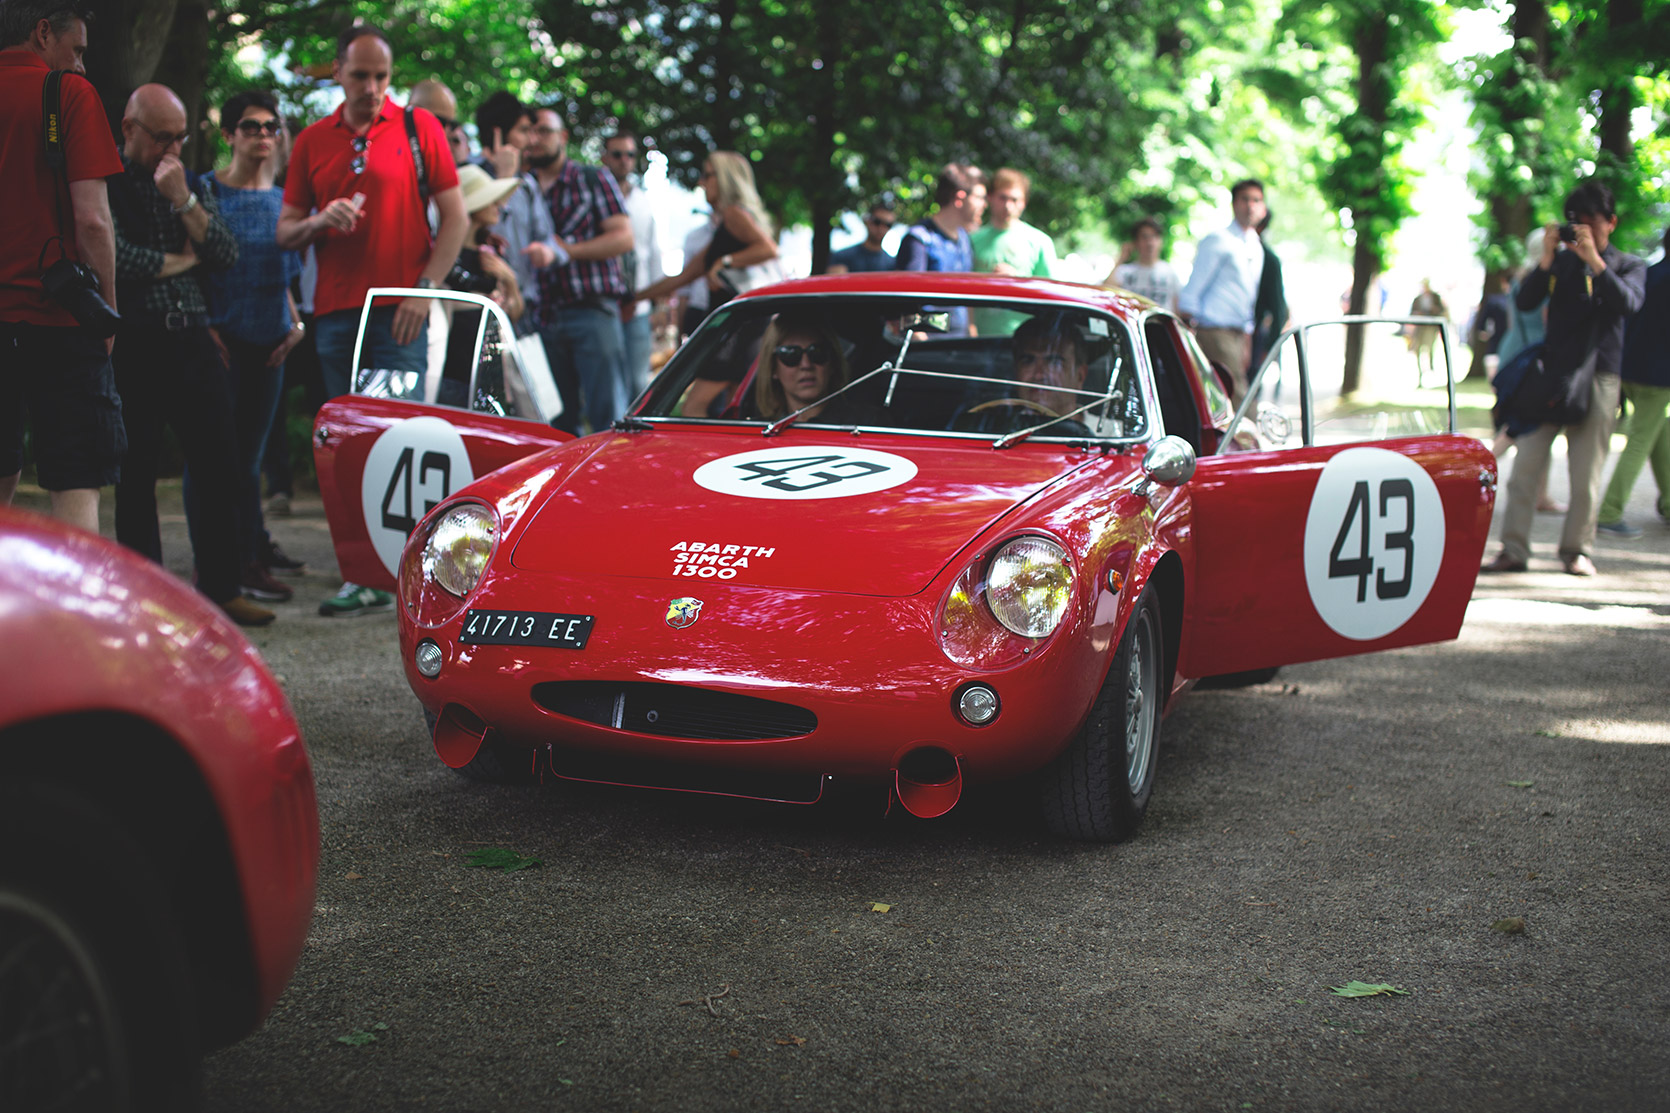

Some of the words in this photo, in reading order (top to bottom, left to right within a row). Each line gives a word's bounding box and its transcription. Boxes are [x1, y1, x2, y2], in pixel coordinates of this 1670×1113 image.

[733, 455, 891, 491] 43
[670, 541, 775, 557] ABARTH
[1328, 478, 1414, 603] 43
[673, 552, 748, 568] SIMCA
[672, 564, 737, 579] 1300
[467, 615, 535, 637] 41713
[548, 618, 581, 640] EE
